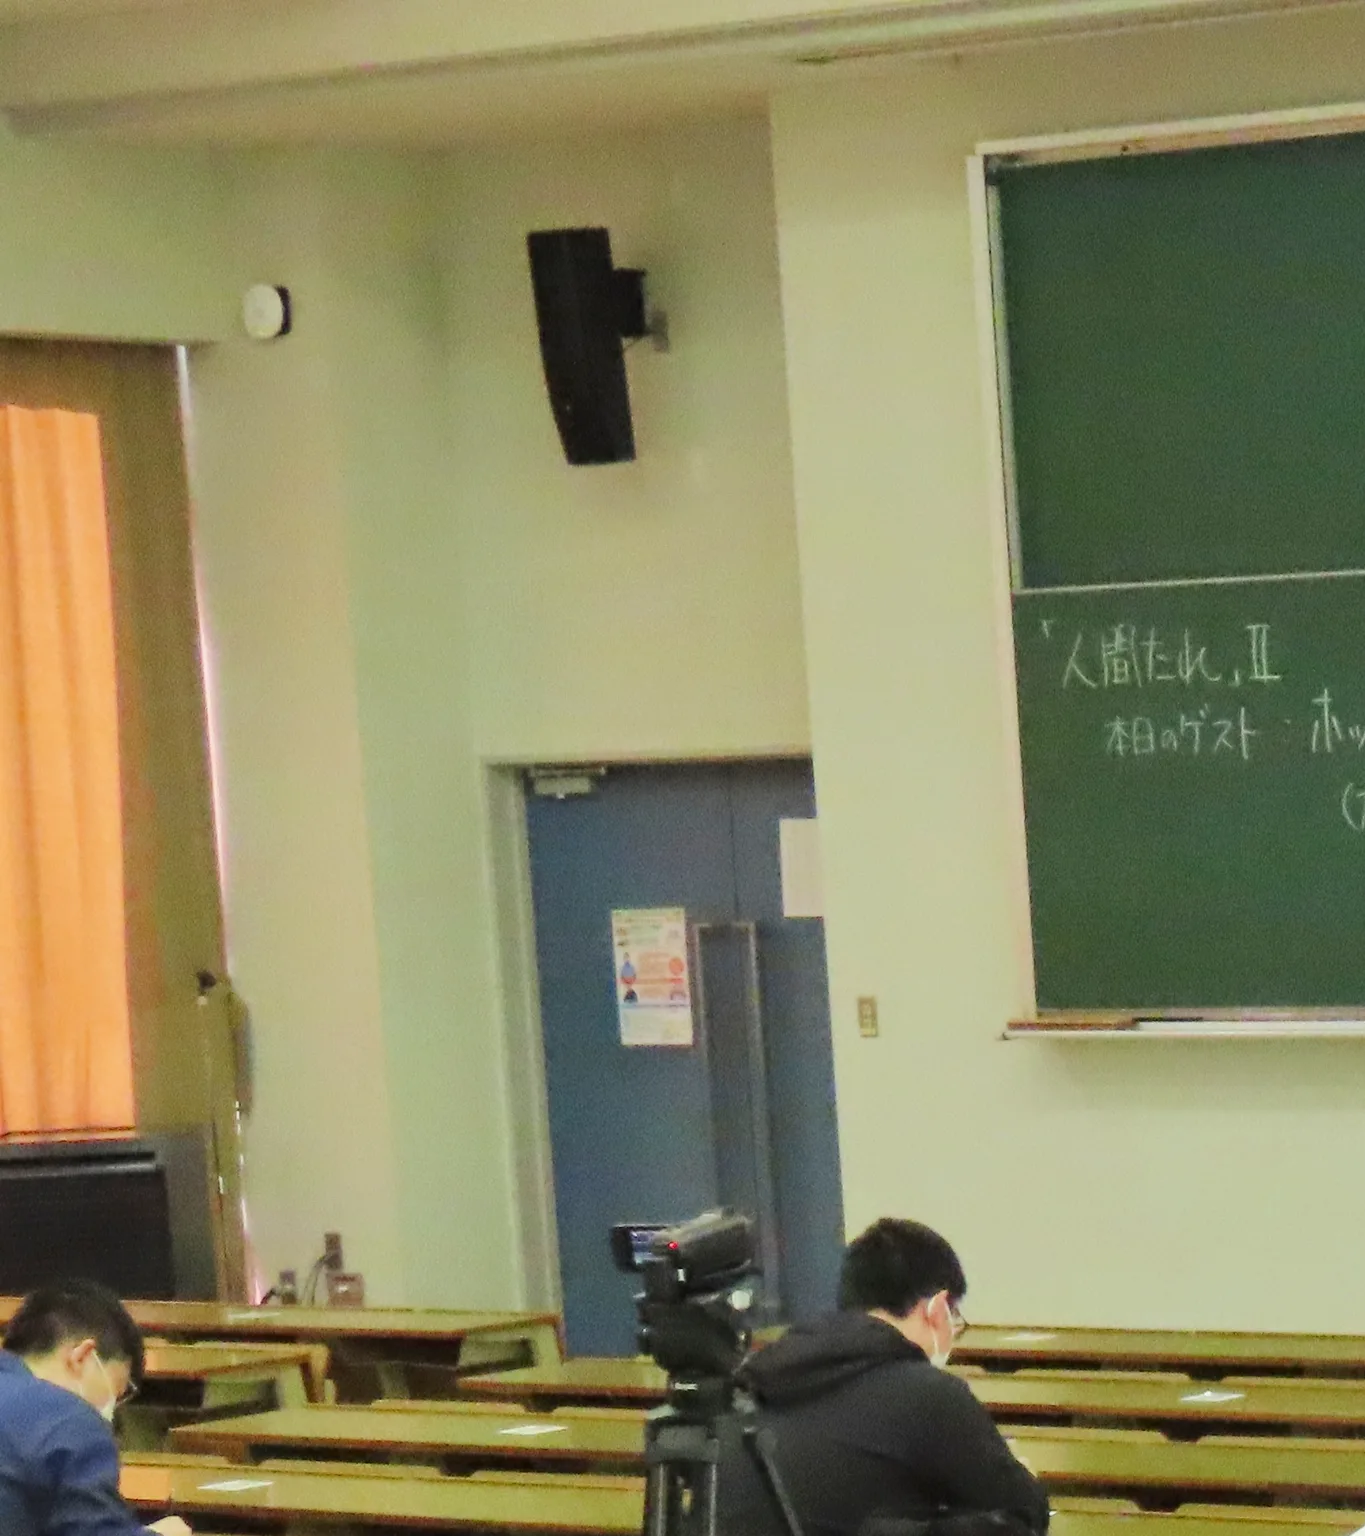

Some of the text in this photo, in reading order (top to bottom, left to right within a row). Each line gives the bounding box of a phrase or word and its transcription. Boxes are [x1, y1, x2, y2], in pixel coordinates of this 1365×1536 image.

[1104, 703, 1257, 760] 本日のゲスト
